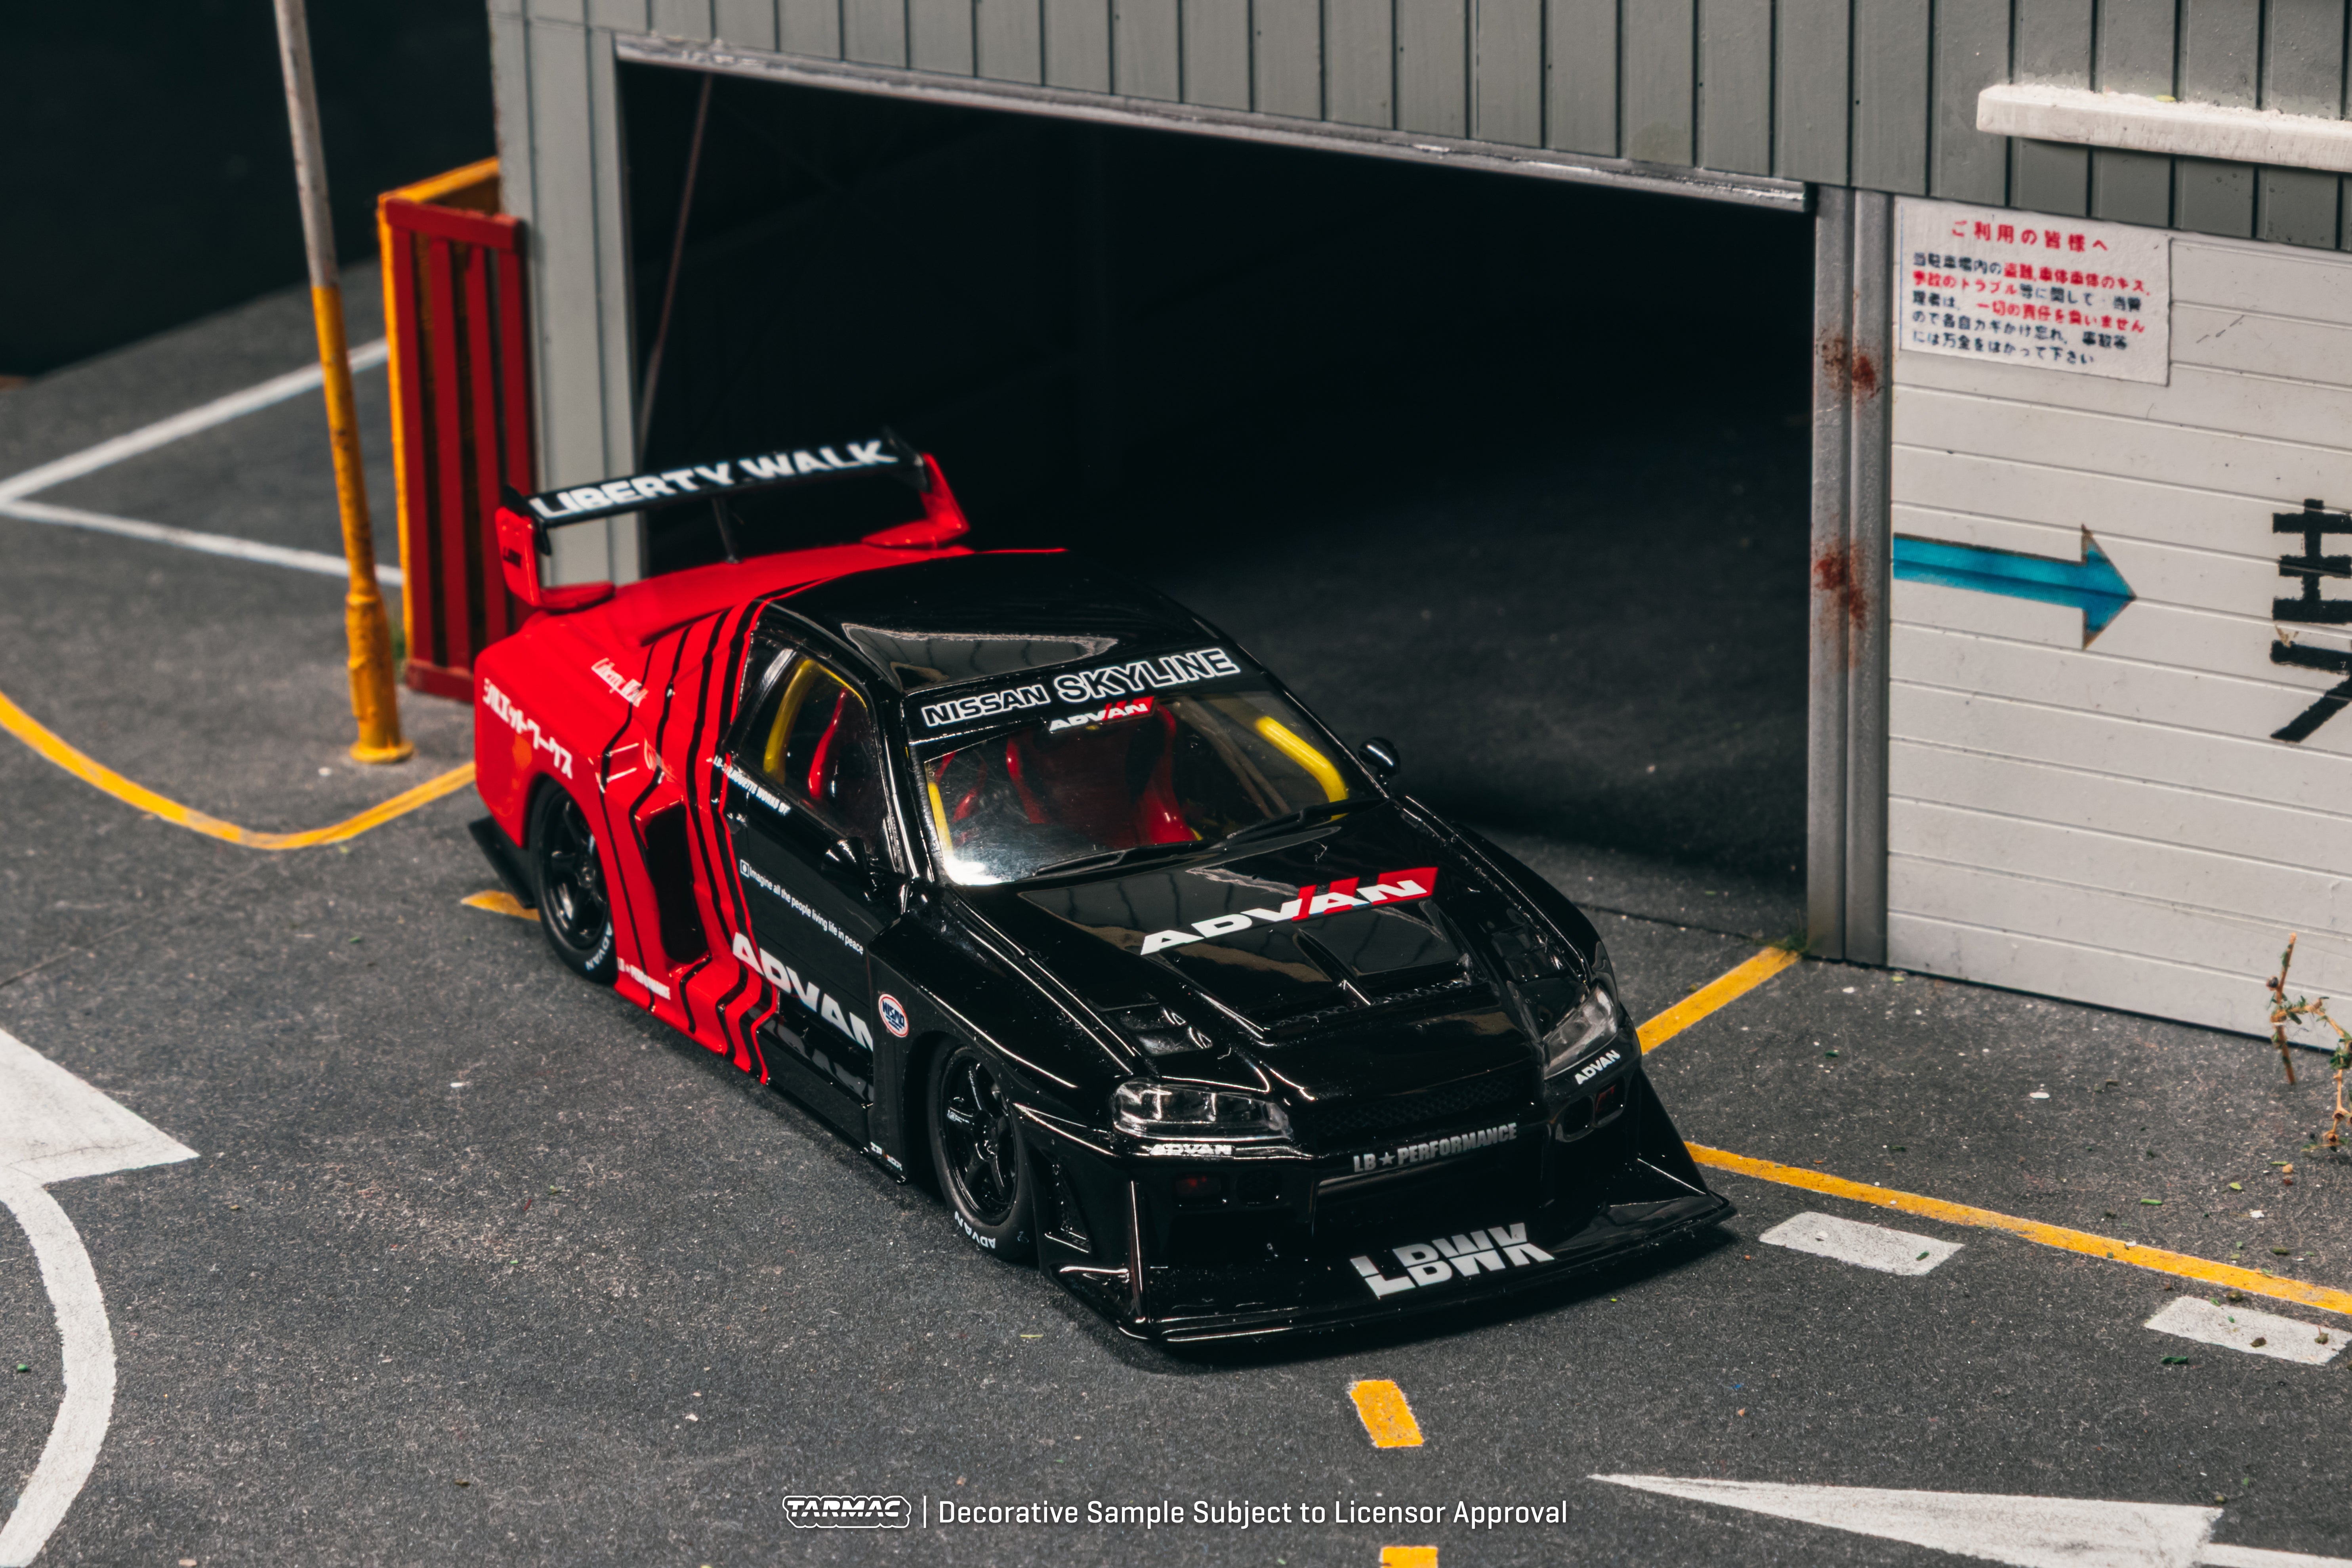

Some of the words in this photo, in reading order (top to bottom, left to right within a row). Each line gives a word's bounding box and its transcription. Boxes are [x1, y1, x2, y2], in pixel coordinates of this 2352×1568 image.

[529, 463, 734, 519] LIBERTY
[734, 440, 900, 480] WALK
[921, 685, 1051, 727] NISSAN
[1053, 648, 1241, 703] SKYLINE
[1048, 703, 1148, 732] ADVAN
[750, 866, 773, 891] Imagine
[781, 888, 791, 903] the
[791, 897, 811, 916] people
[812, 908, 828, 931] living
[828, 920, 838, 936] life
[837, 927, 845, 941] in
[845, 935, 864, 956] peace
[1140, 879, 1427, 956] ADVAN
[585, 921, 613, 971] ADVAN
[1574, 1049, 1621, 1085] ADVAN
[1353, 1153, 1376, 1173] LB
[1397, 1122, 1517, 1166] PERFORMANCE
[954, 1210, 996, 1249] ADVAN
[1350, 1222, 1555, 1300] LBWK
